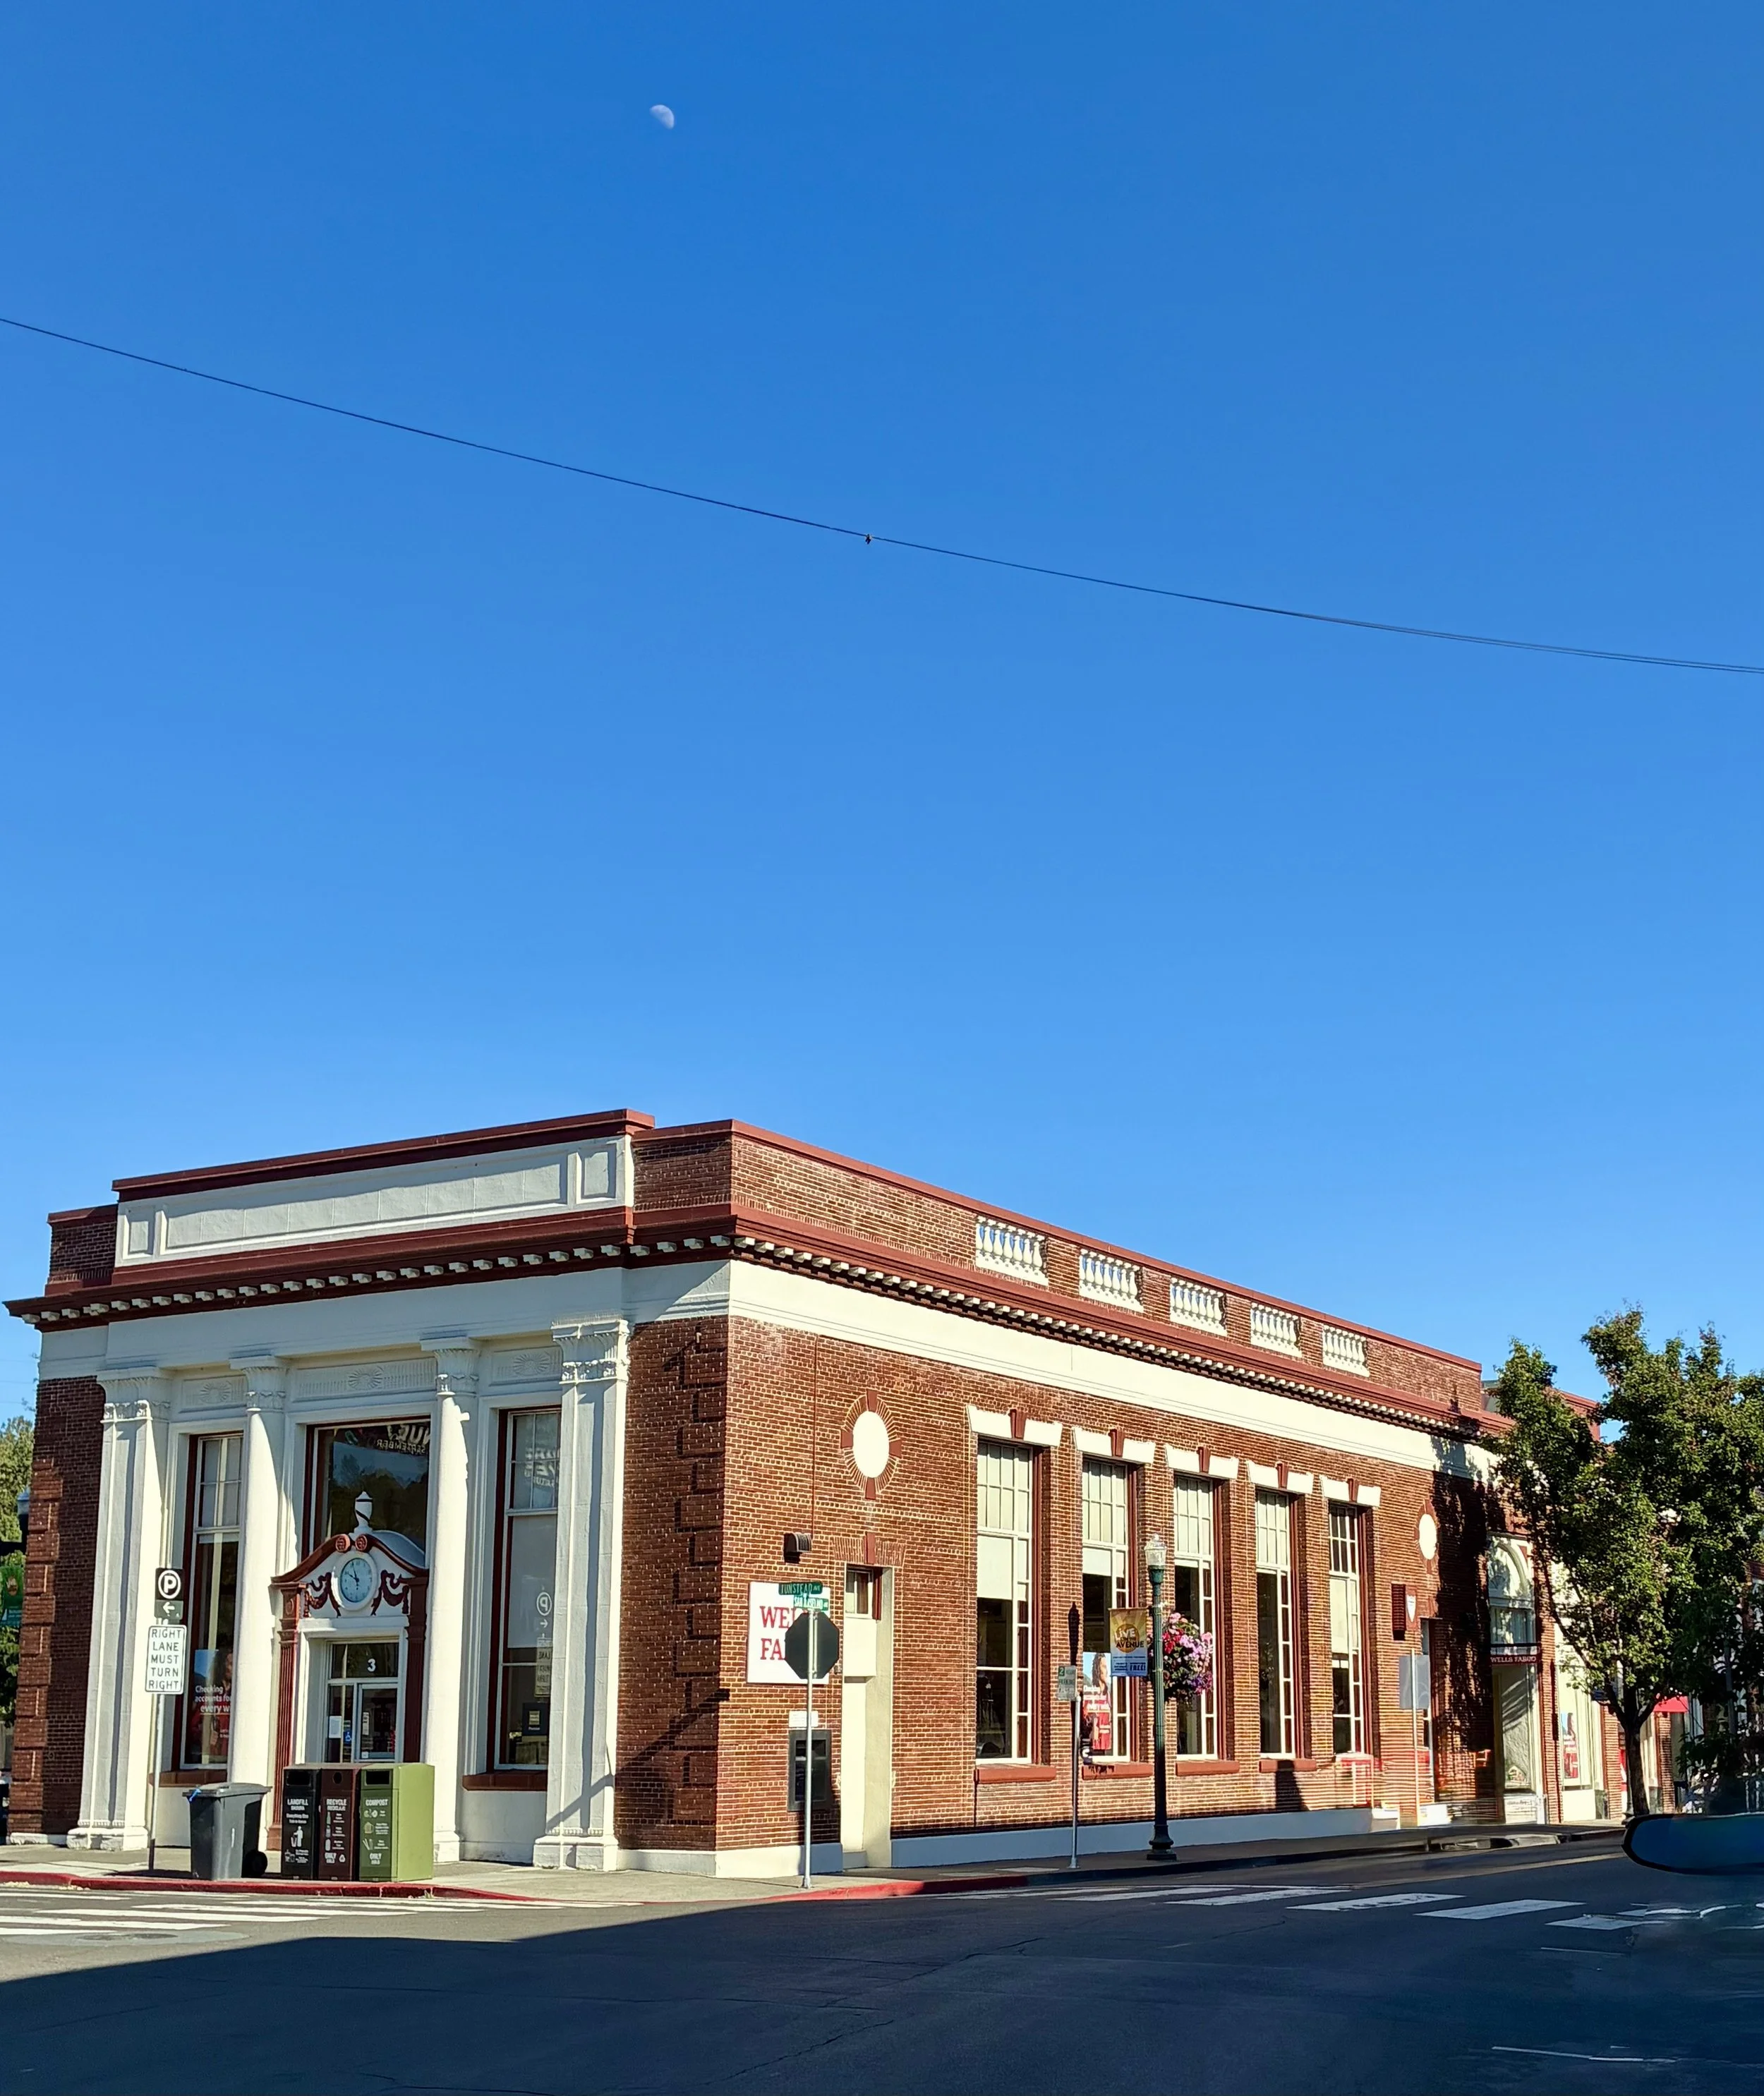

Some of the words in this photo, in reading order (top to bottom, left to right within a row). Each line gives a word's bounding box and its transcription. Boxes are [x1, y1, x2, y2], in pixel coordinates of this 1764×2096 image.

[780, 1583, 812, 1594] TUNSTEAD
[151, 1629, 181, 1639] RIGHT
[152, 1642, 179, 1652] LANE
[150, 1655, 179, 1664] MUST
[367, 1658, 376, 1673] 3
[150, 1667, 179, 1678] TURN
[149, 1680, 179, 1690] RIGHT
[195, 1685, 224, 1694] Checking
[200, 1706, 222, 1714] every
